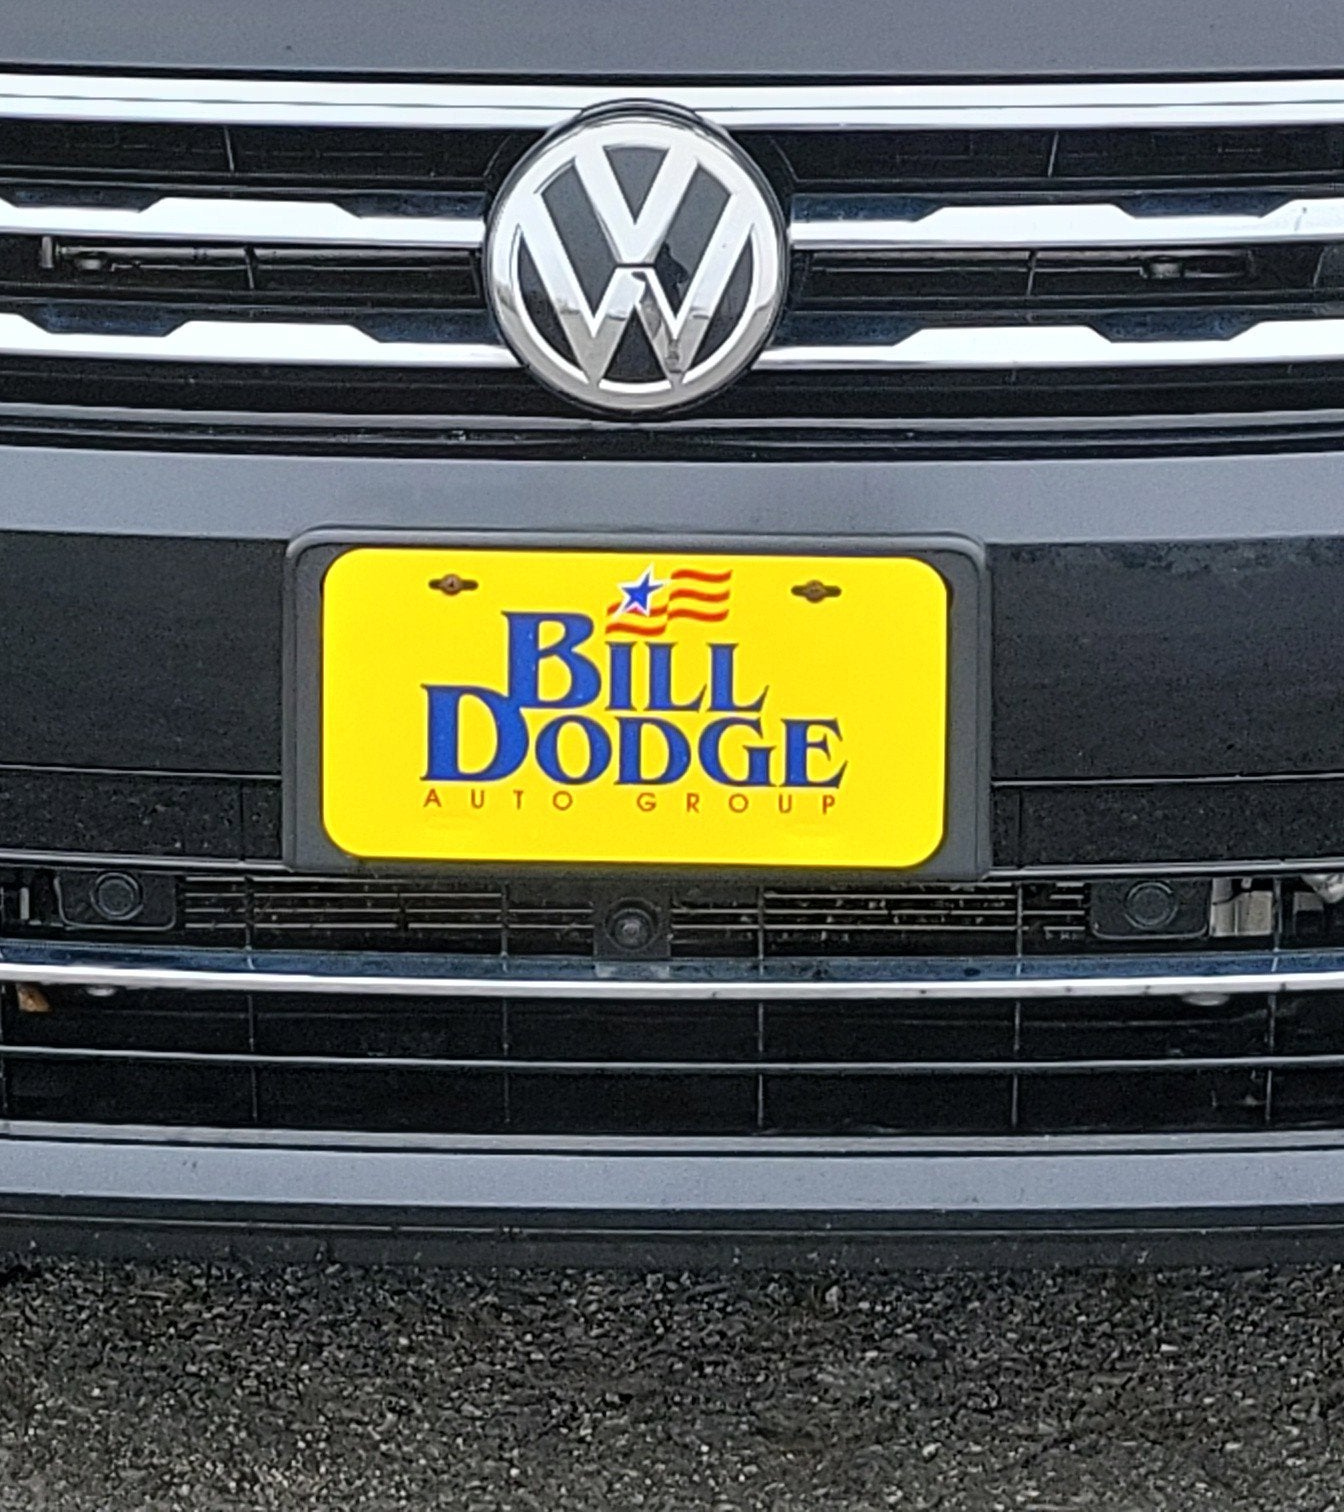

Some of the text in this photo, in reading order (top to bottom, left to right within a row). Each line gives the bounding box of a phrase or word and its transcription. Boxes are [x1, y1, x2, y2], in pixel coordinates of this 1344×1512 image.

[500, 610, 770, 712] BILL
[419, 683, 849, 789] DODGE
[422, 788, 838, 816] AUTO GROUP
